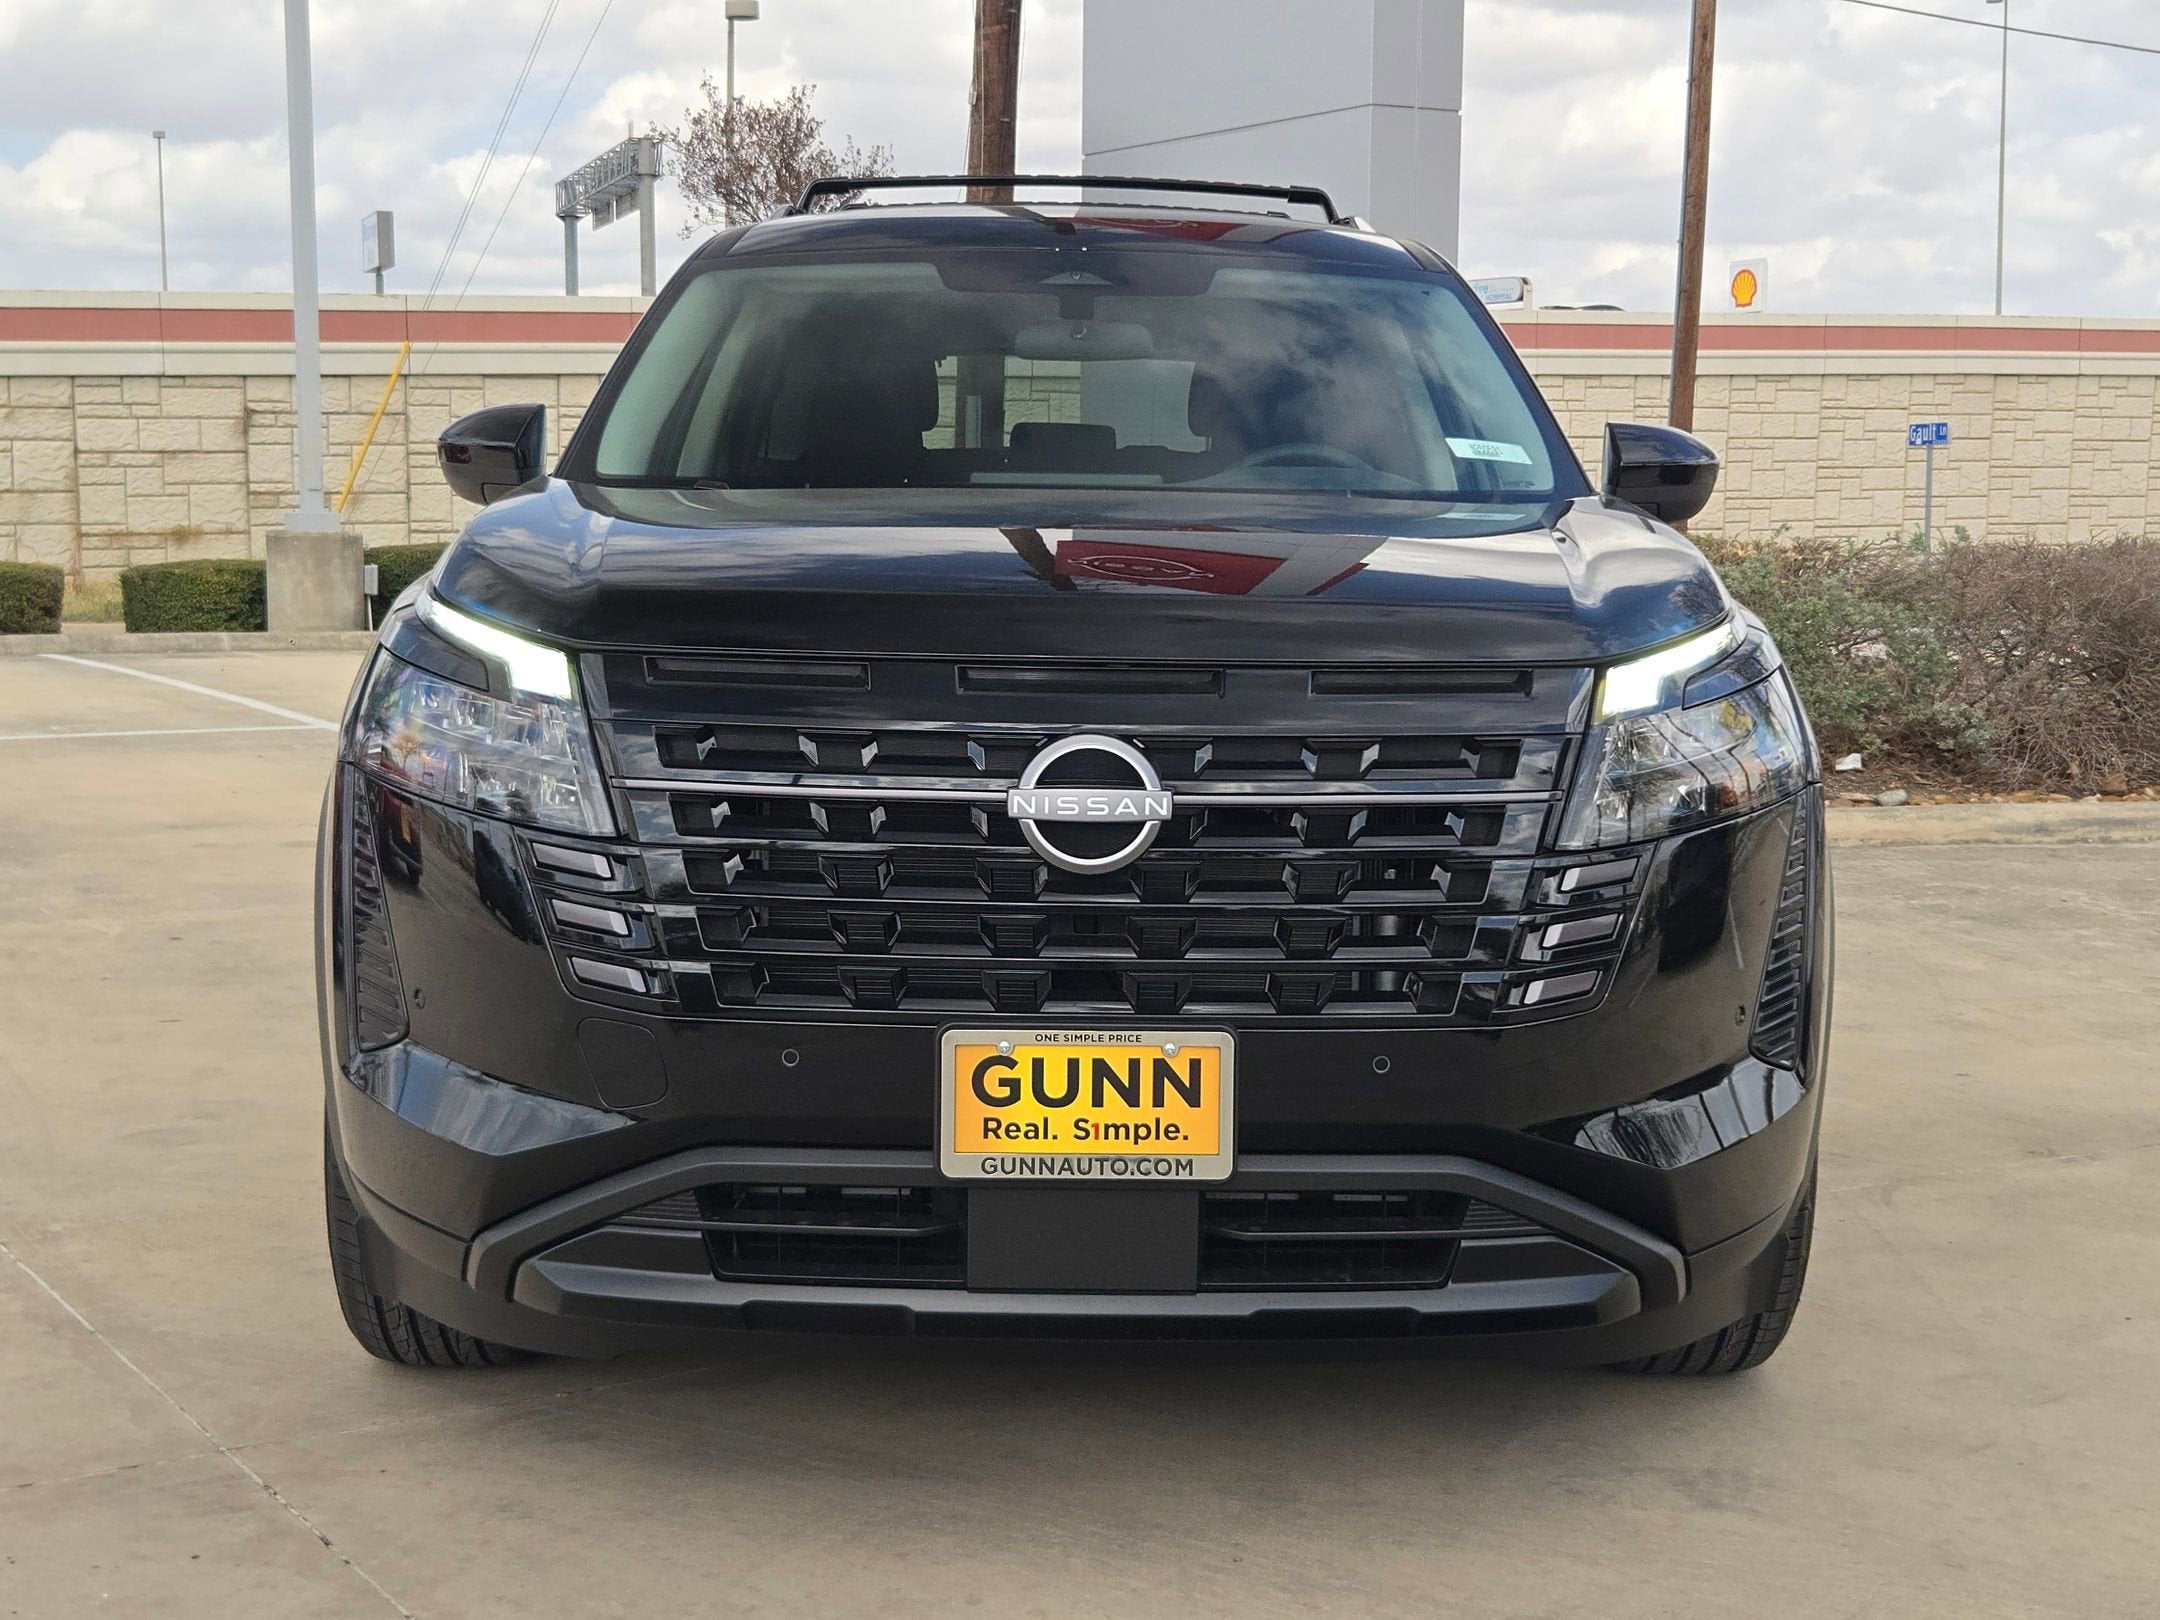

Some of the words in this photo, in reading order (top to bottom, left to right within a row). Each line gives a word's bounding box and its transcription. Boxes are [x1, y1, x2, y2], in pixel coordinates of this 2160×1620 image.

[1910, 423, 1936, 441] Gault
[1013, 795, 1168, 816] NISSAN
[1035, 1033, 1059, 1042] ONE
[1063, 1033, 1104, 1043] SIMPLE
[1109, 1034, 1142, 1043] PRICE
[971, 1055, 1202, 1109] GUNN
[983, 1116, 1058, 1140] Real.
[981, 1156, 1194, 1176] GUNNAUTO.COM
